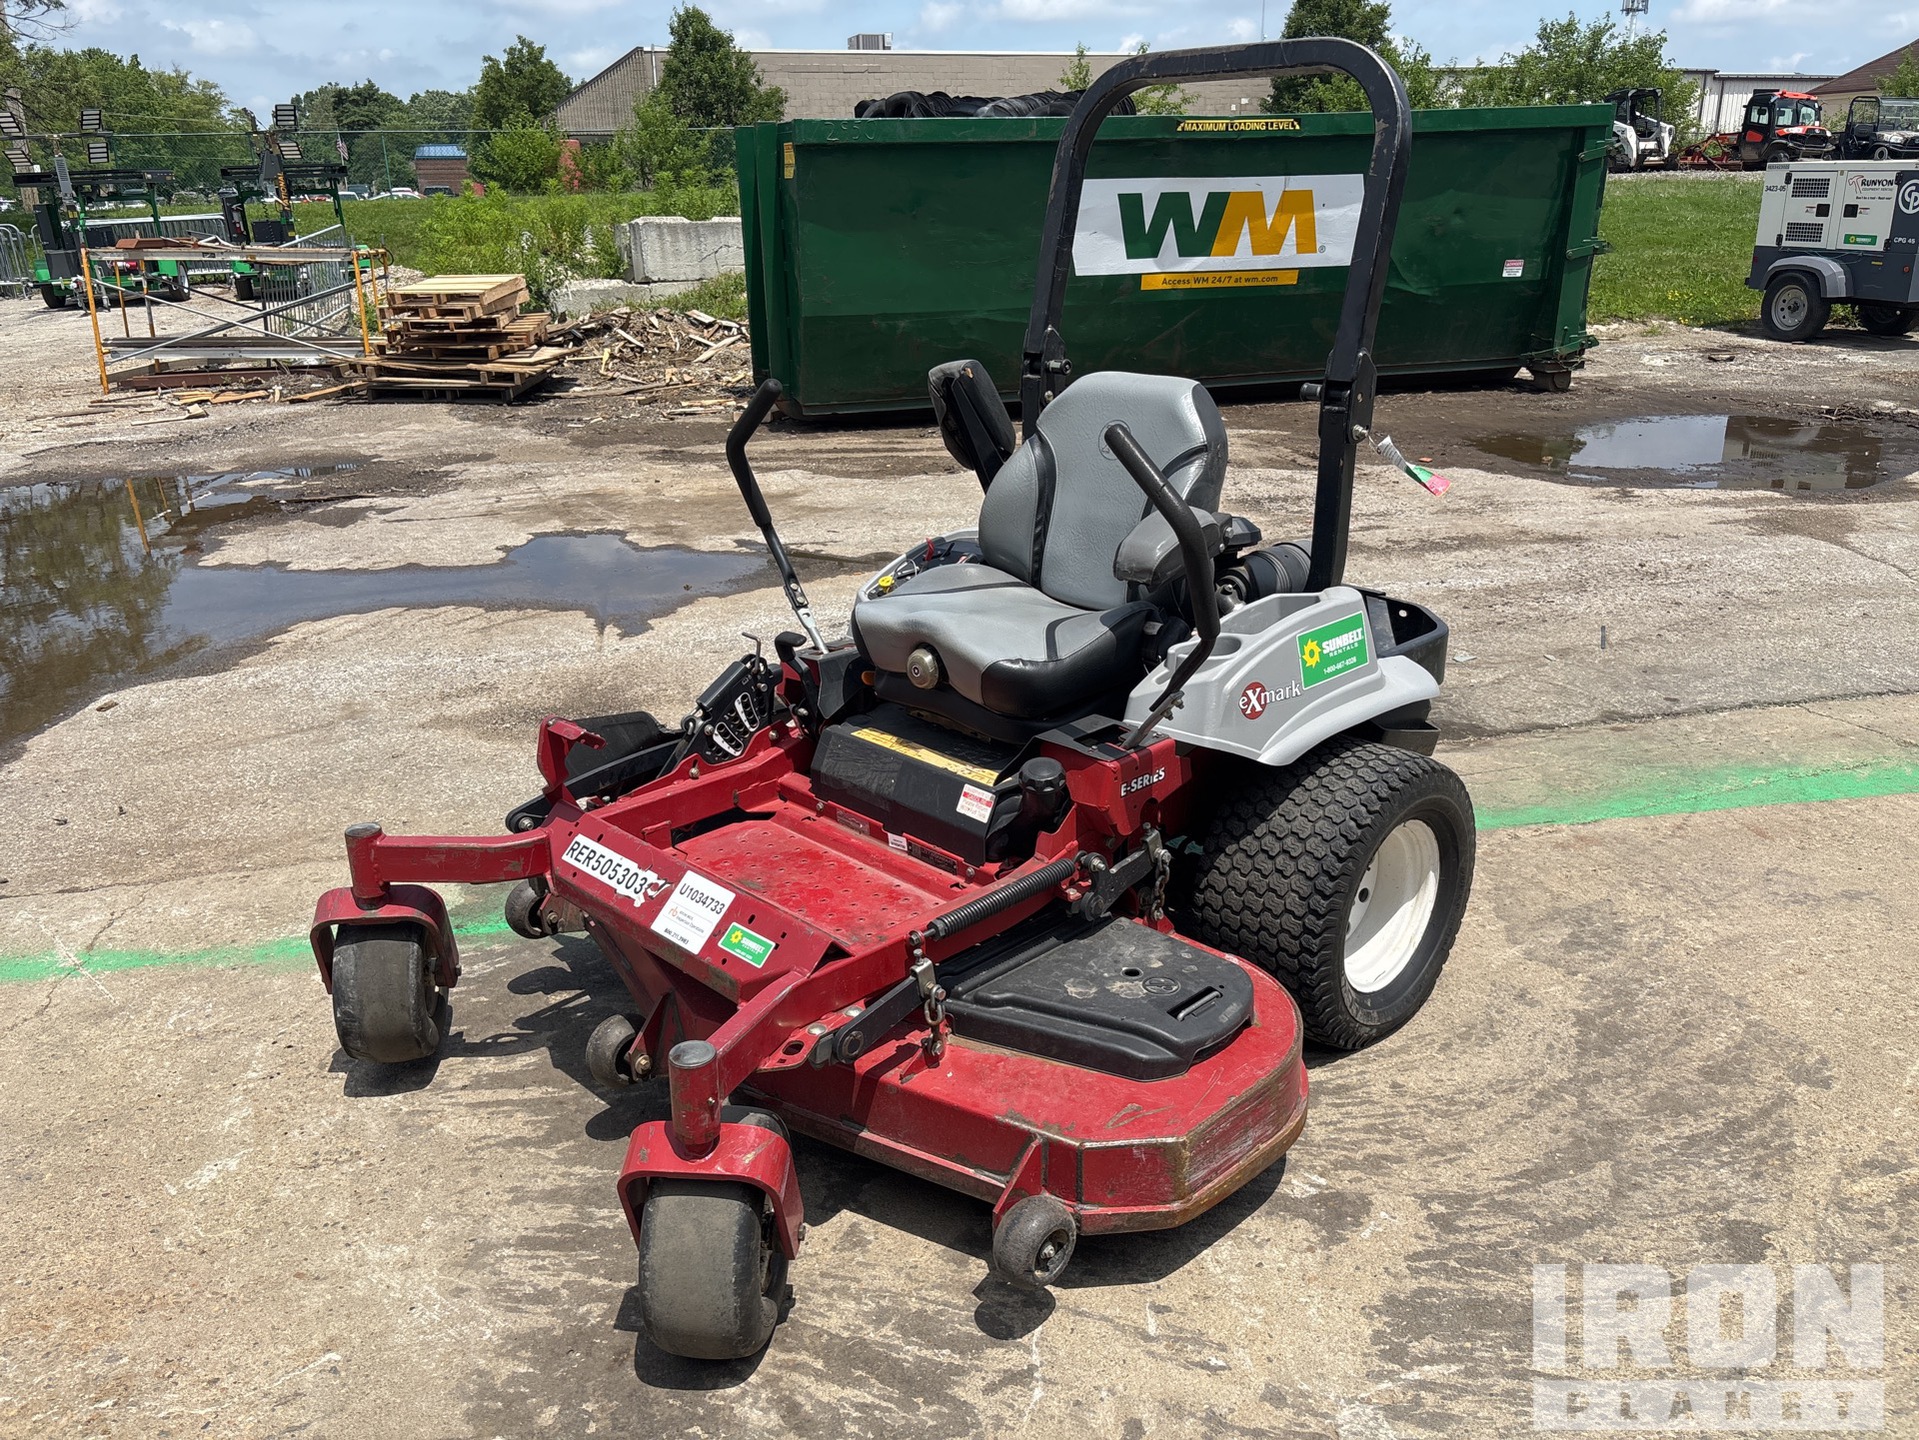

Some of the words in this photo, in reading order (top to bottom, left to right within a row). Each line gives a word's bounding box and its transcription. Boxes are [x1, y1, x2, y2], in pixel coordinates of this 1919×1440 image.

[1184, 122, 1226, 131] MAXIMUM
[1228, 122, 1266, 131] LOADING
[1268, 121, 1294, 130] LEVEL
[1861, 178, 1894, 187] RUNYON
[1117, 189, 1318, 260] WM
[1161, 277, 1190, 286] Access
[1193, 276, 1209, 284] WM
[1211, 275, 1232, 284] 24/7
[1244, 275, 1278, 284] wm.com
[1322, 628, 1363, 654] SUNBELT
[1329, 642, 1359, 657] RENTALS
[679, 882, 726, 915] U1034733
